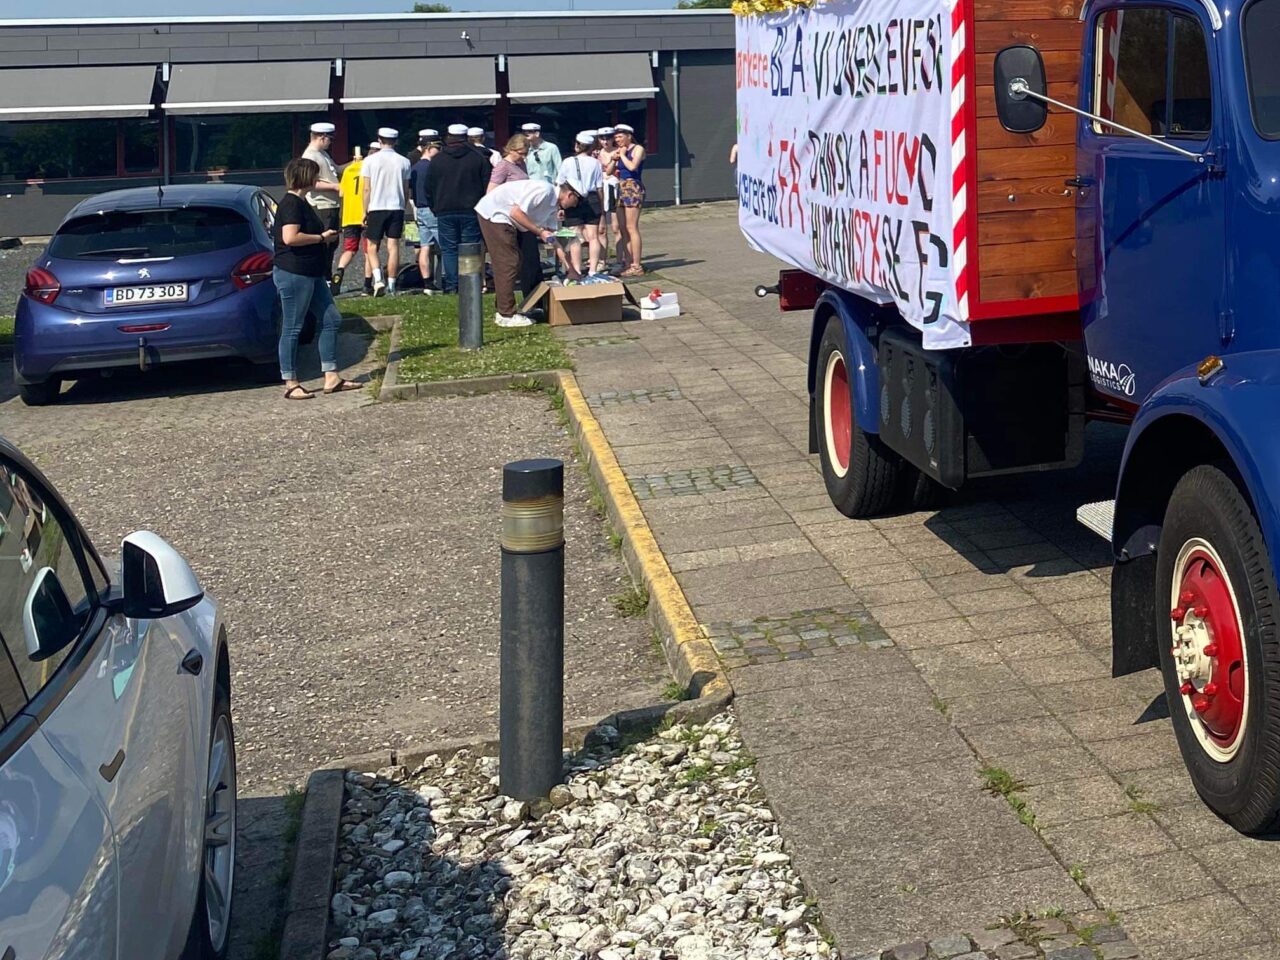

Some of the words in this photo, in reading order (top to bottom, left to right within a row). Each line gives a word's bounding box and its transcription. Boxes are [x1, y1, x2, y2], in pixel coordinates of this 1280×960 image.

[736, 44, 769, 90] ørkere
[808, 128, 855, 198] DANSK
[115, 288, 135, 301] BD
[138, 286, 155, 299] 73
[158, 284, 185, 298] 303
[1087, 354, 1119, 381] NAKA
